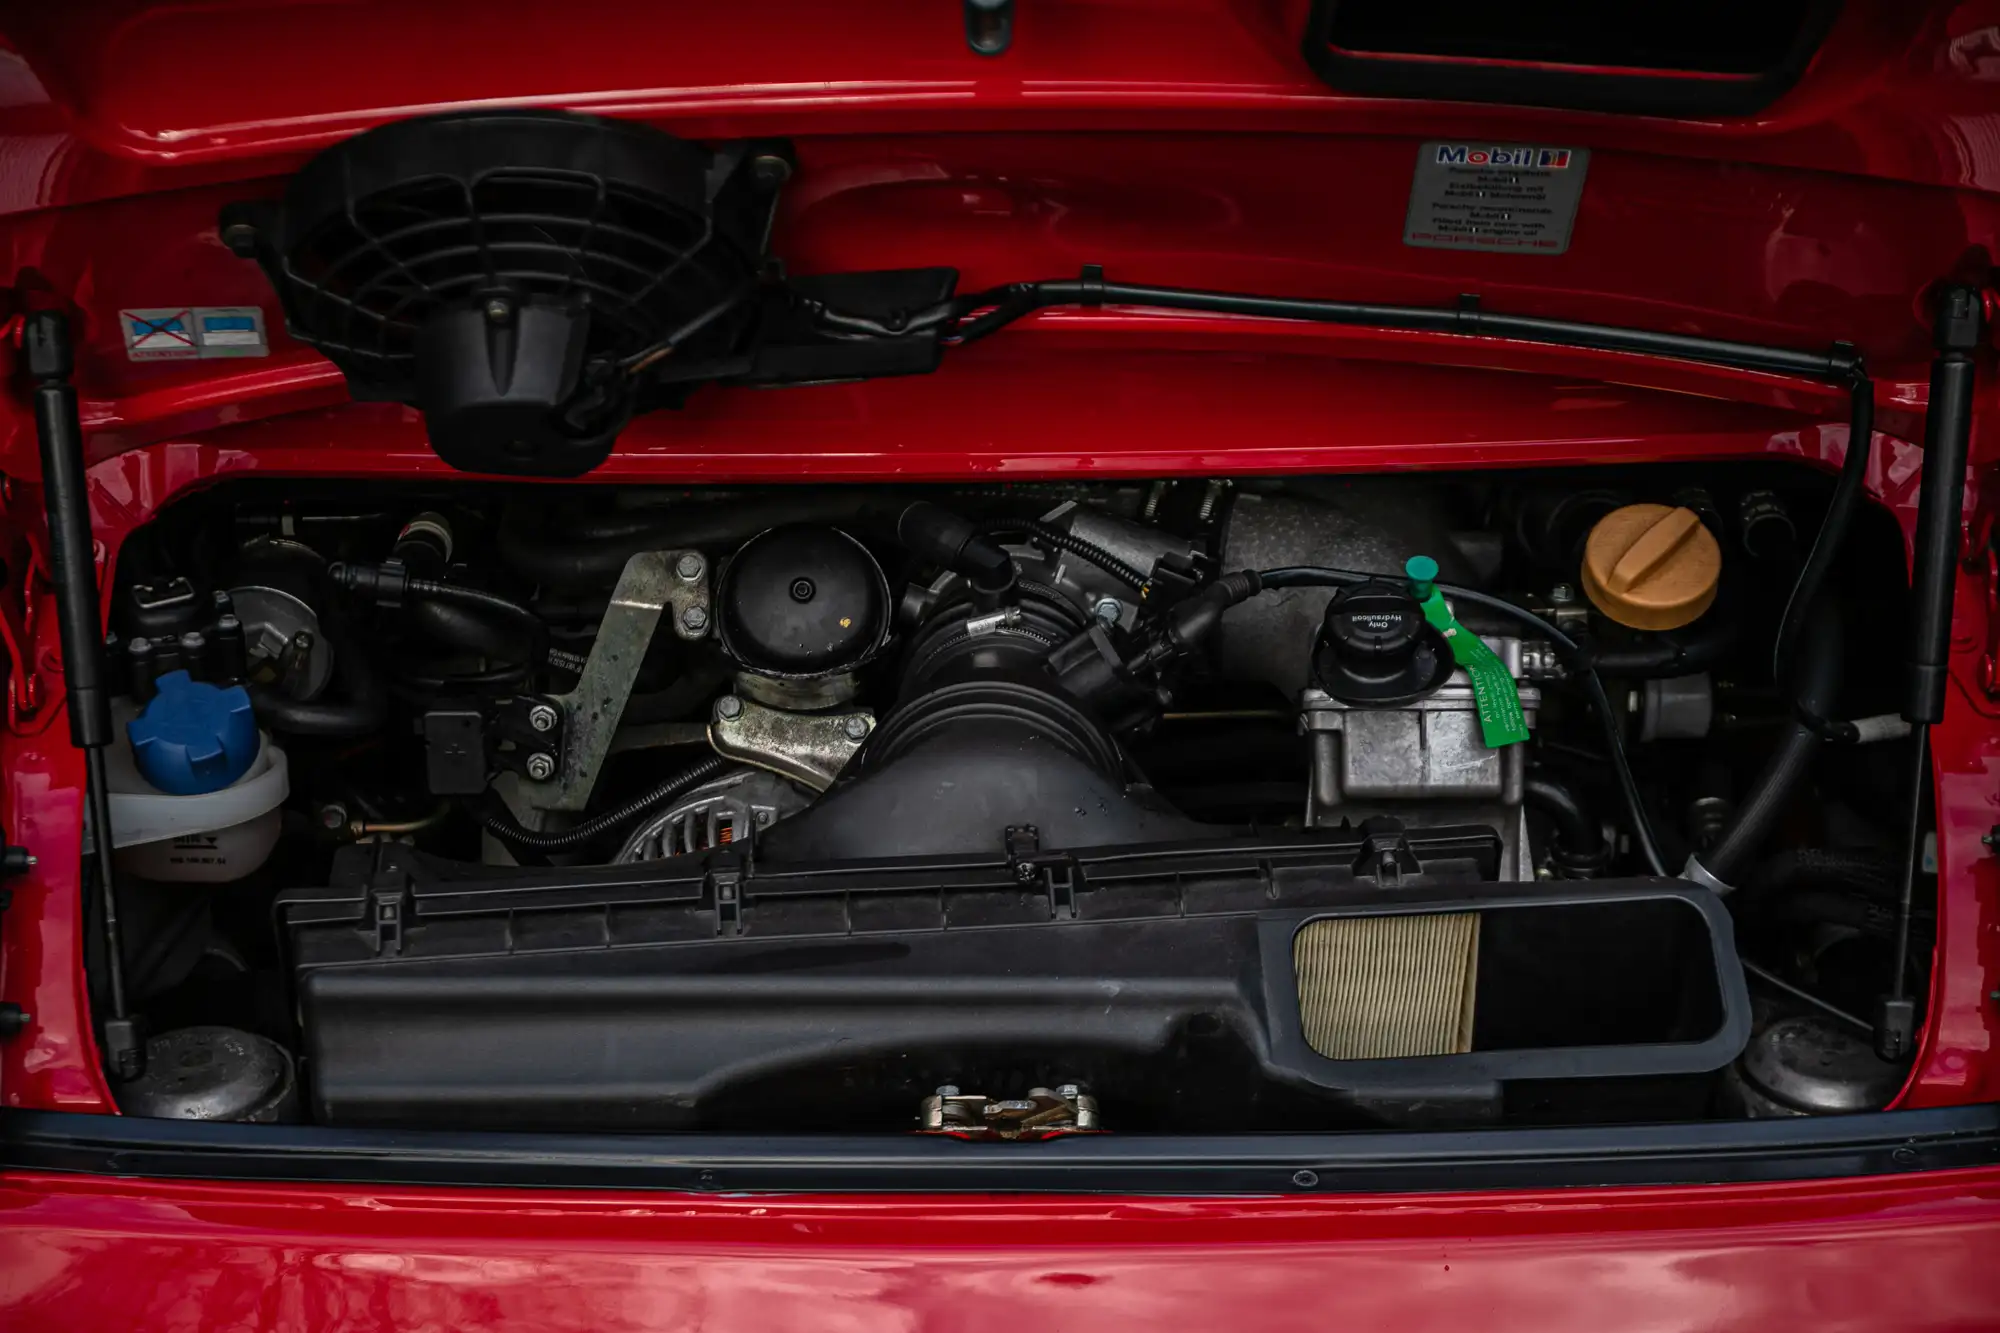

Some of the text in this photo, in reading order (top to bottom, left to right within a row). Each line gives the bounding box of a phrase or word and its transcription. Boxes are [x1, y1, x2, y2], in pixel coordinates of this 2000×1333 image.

[1436, 145, 1533, 166] Mobil
[1368, 621, 1389, 629] Only
[1468, 664, 1493, 723] ATTENTION
